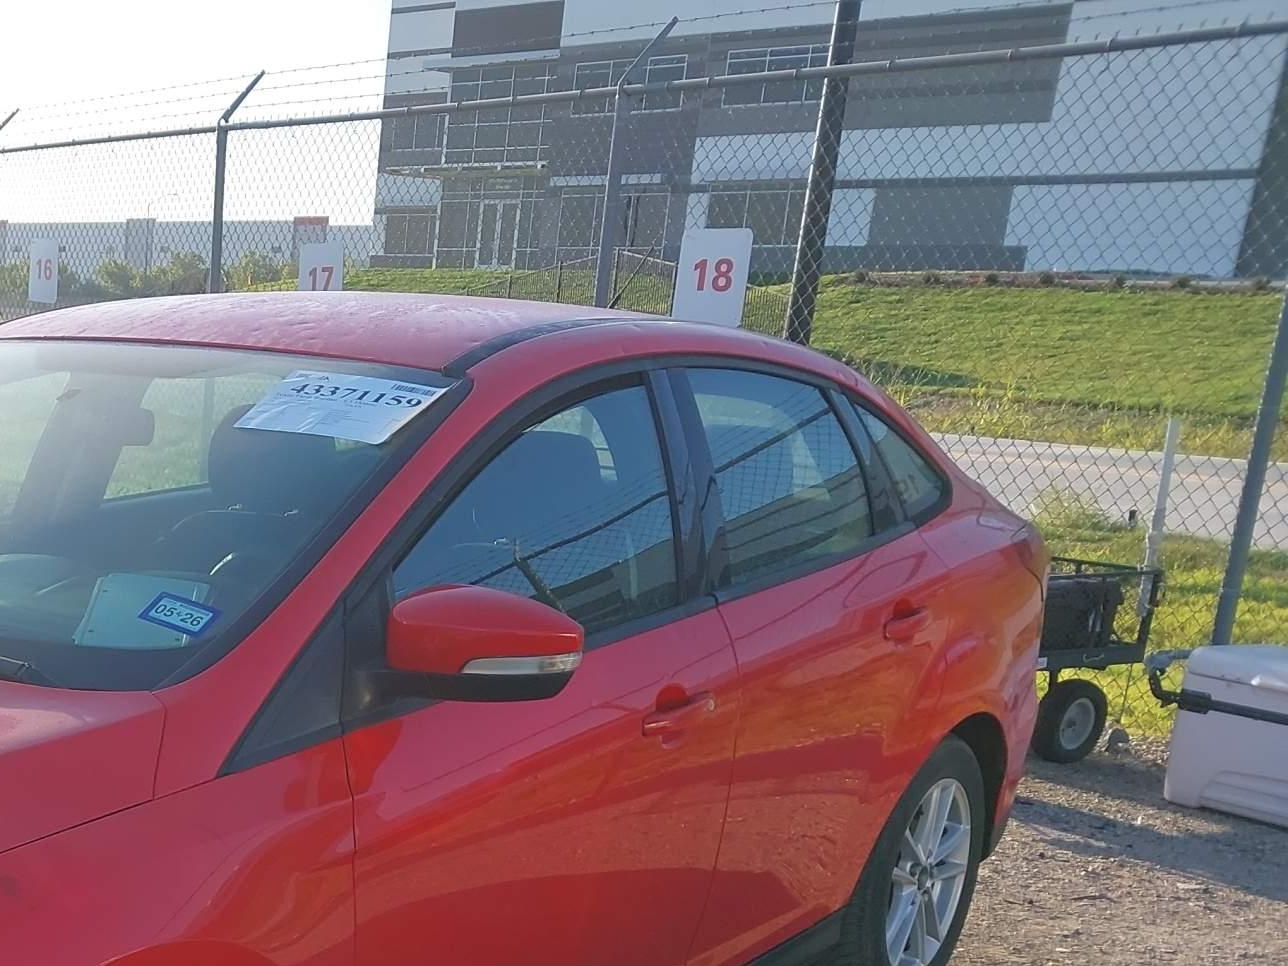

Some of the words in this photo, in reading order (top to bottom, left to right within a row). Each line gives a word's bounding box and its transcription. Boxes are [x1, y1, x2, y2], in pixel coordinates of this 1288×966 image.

[36, 258, 52, 280] 16
[309, 266, 334, 291] 17
[694, 258, 734, 292] 18
[290, 382, 423, 409] 43371159
